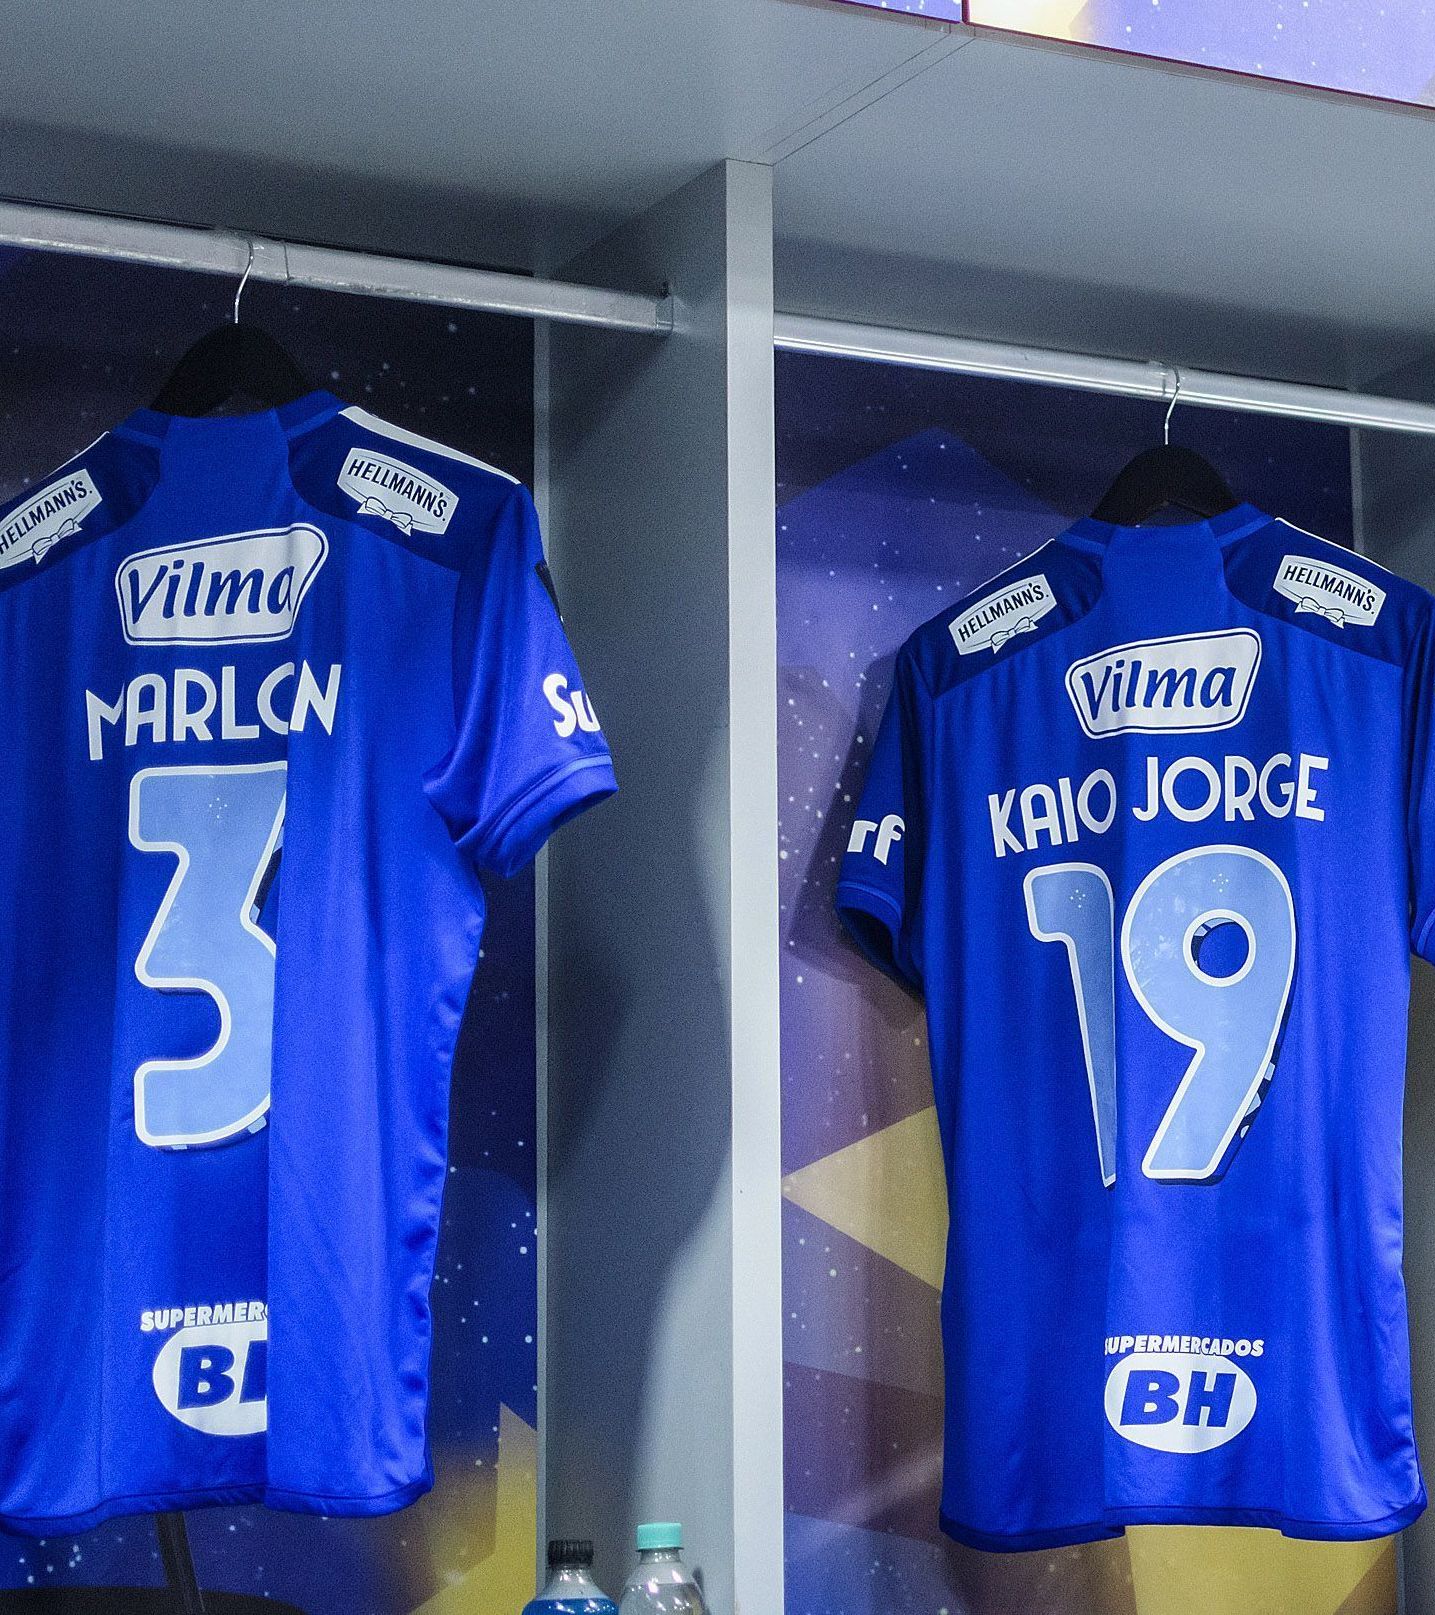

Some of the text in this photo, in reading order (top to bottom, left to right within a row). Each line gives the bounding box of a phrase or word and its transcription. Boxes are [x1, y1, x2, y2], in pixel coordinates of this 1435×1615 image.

[128, 559, 295, 625] Vilma
[1080, 659, 1237, 721] Vilma
[988, 753, 1329, 858] KAIO JORGE
[128, 760, 287, 1148] 3
[1023, 844, 1296, 1189] 19
[140, 1301, 268, 1332] SUPERMER
[1120, 1370, 1237, 1428] BH
